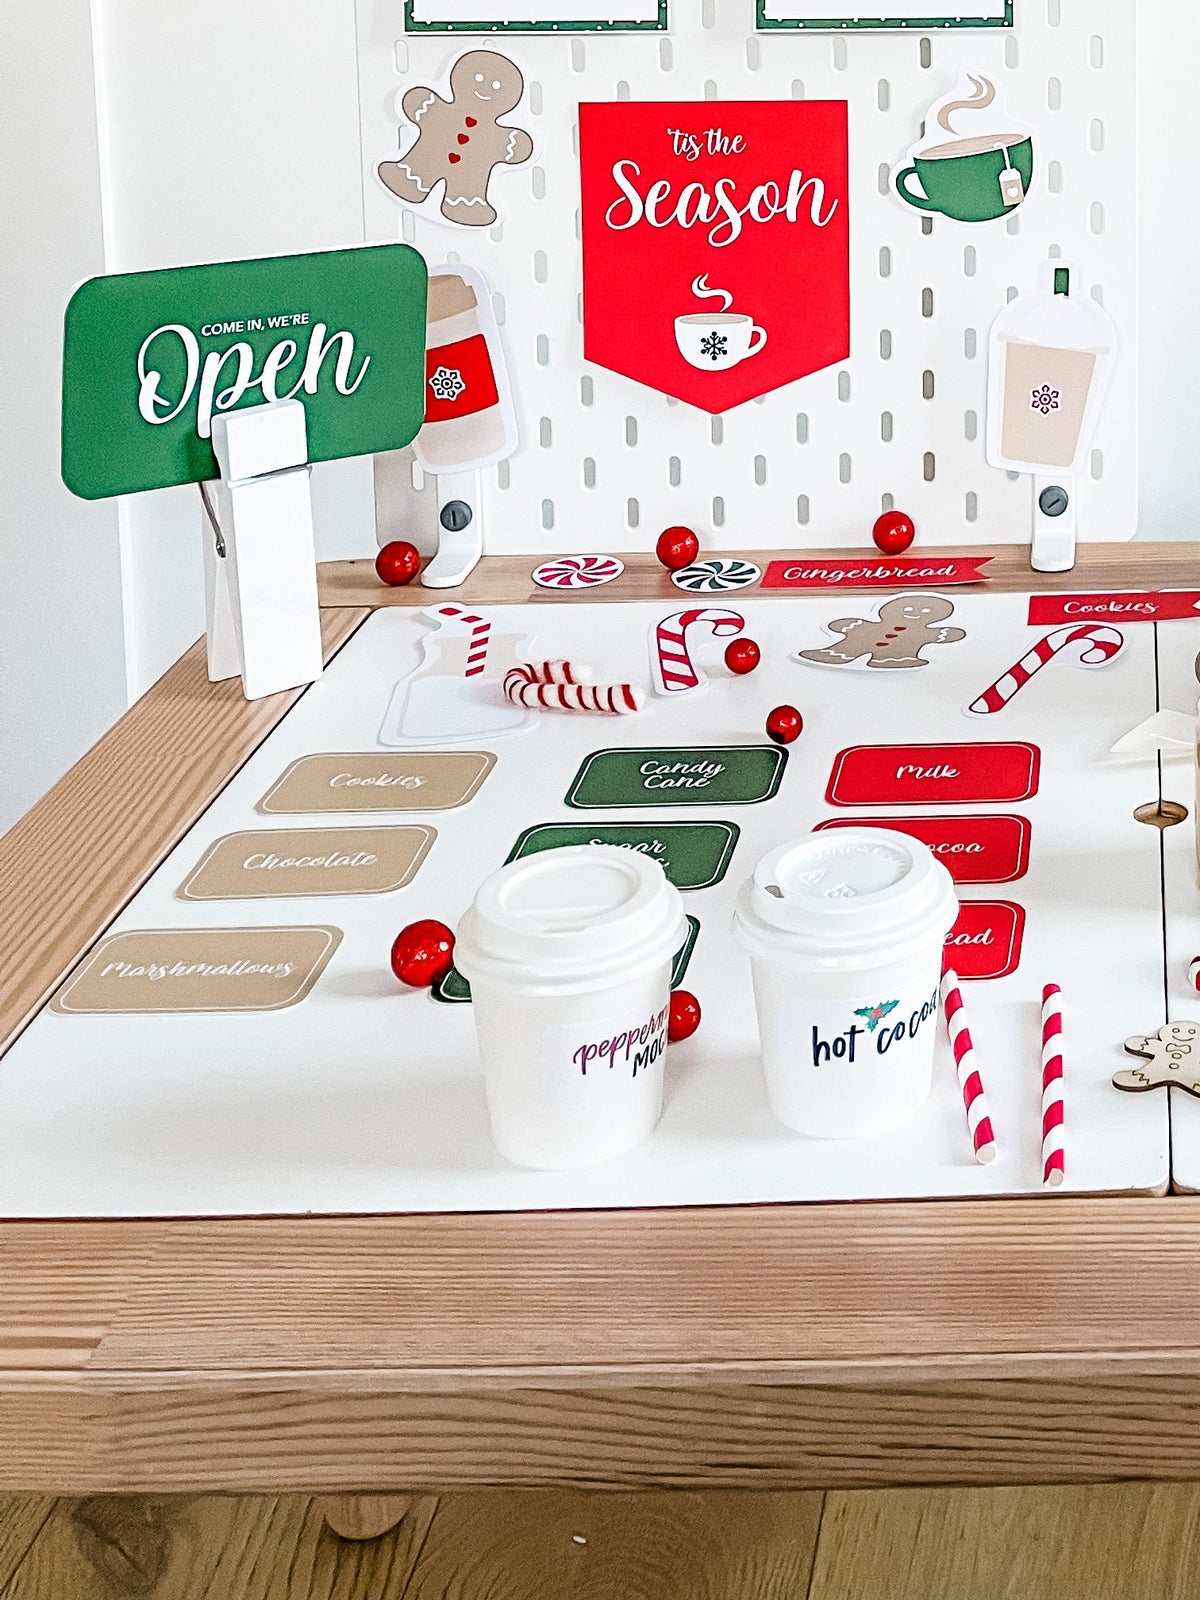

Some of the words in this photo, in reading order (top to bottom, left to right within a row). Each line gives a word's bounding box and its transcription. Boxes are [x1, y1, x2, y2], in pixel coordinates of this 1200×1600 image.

[701, 128, 746, 156] the
[605, 160, 839, 247] Season
[201, 321, 244, 336] COME
[247, 318, 265, 331] IN,
[267, 312, 309, 328] WE'RE
[137, 322, 371, 438] Open
[783, 564, 958, 585] Gingerbread
[1062, 600, 1159, 615] Cookies
[640, 761, 726, 778] Candy
[896, 765, 961, 780] Milk
[329, 771, 425, 790] Cookies
[644, 775, 711, 789] Cane
[242, 851, 378, 872] Chocolate
[101, 959, 297, 981] Marshmallows
[812, 1025, 865, 1067] hot
[877, 984, 938, 1055] cocoa
